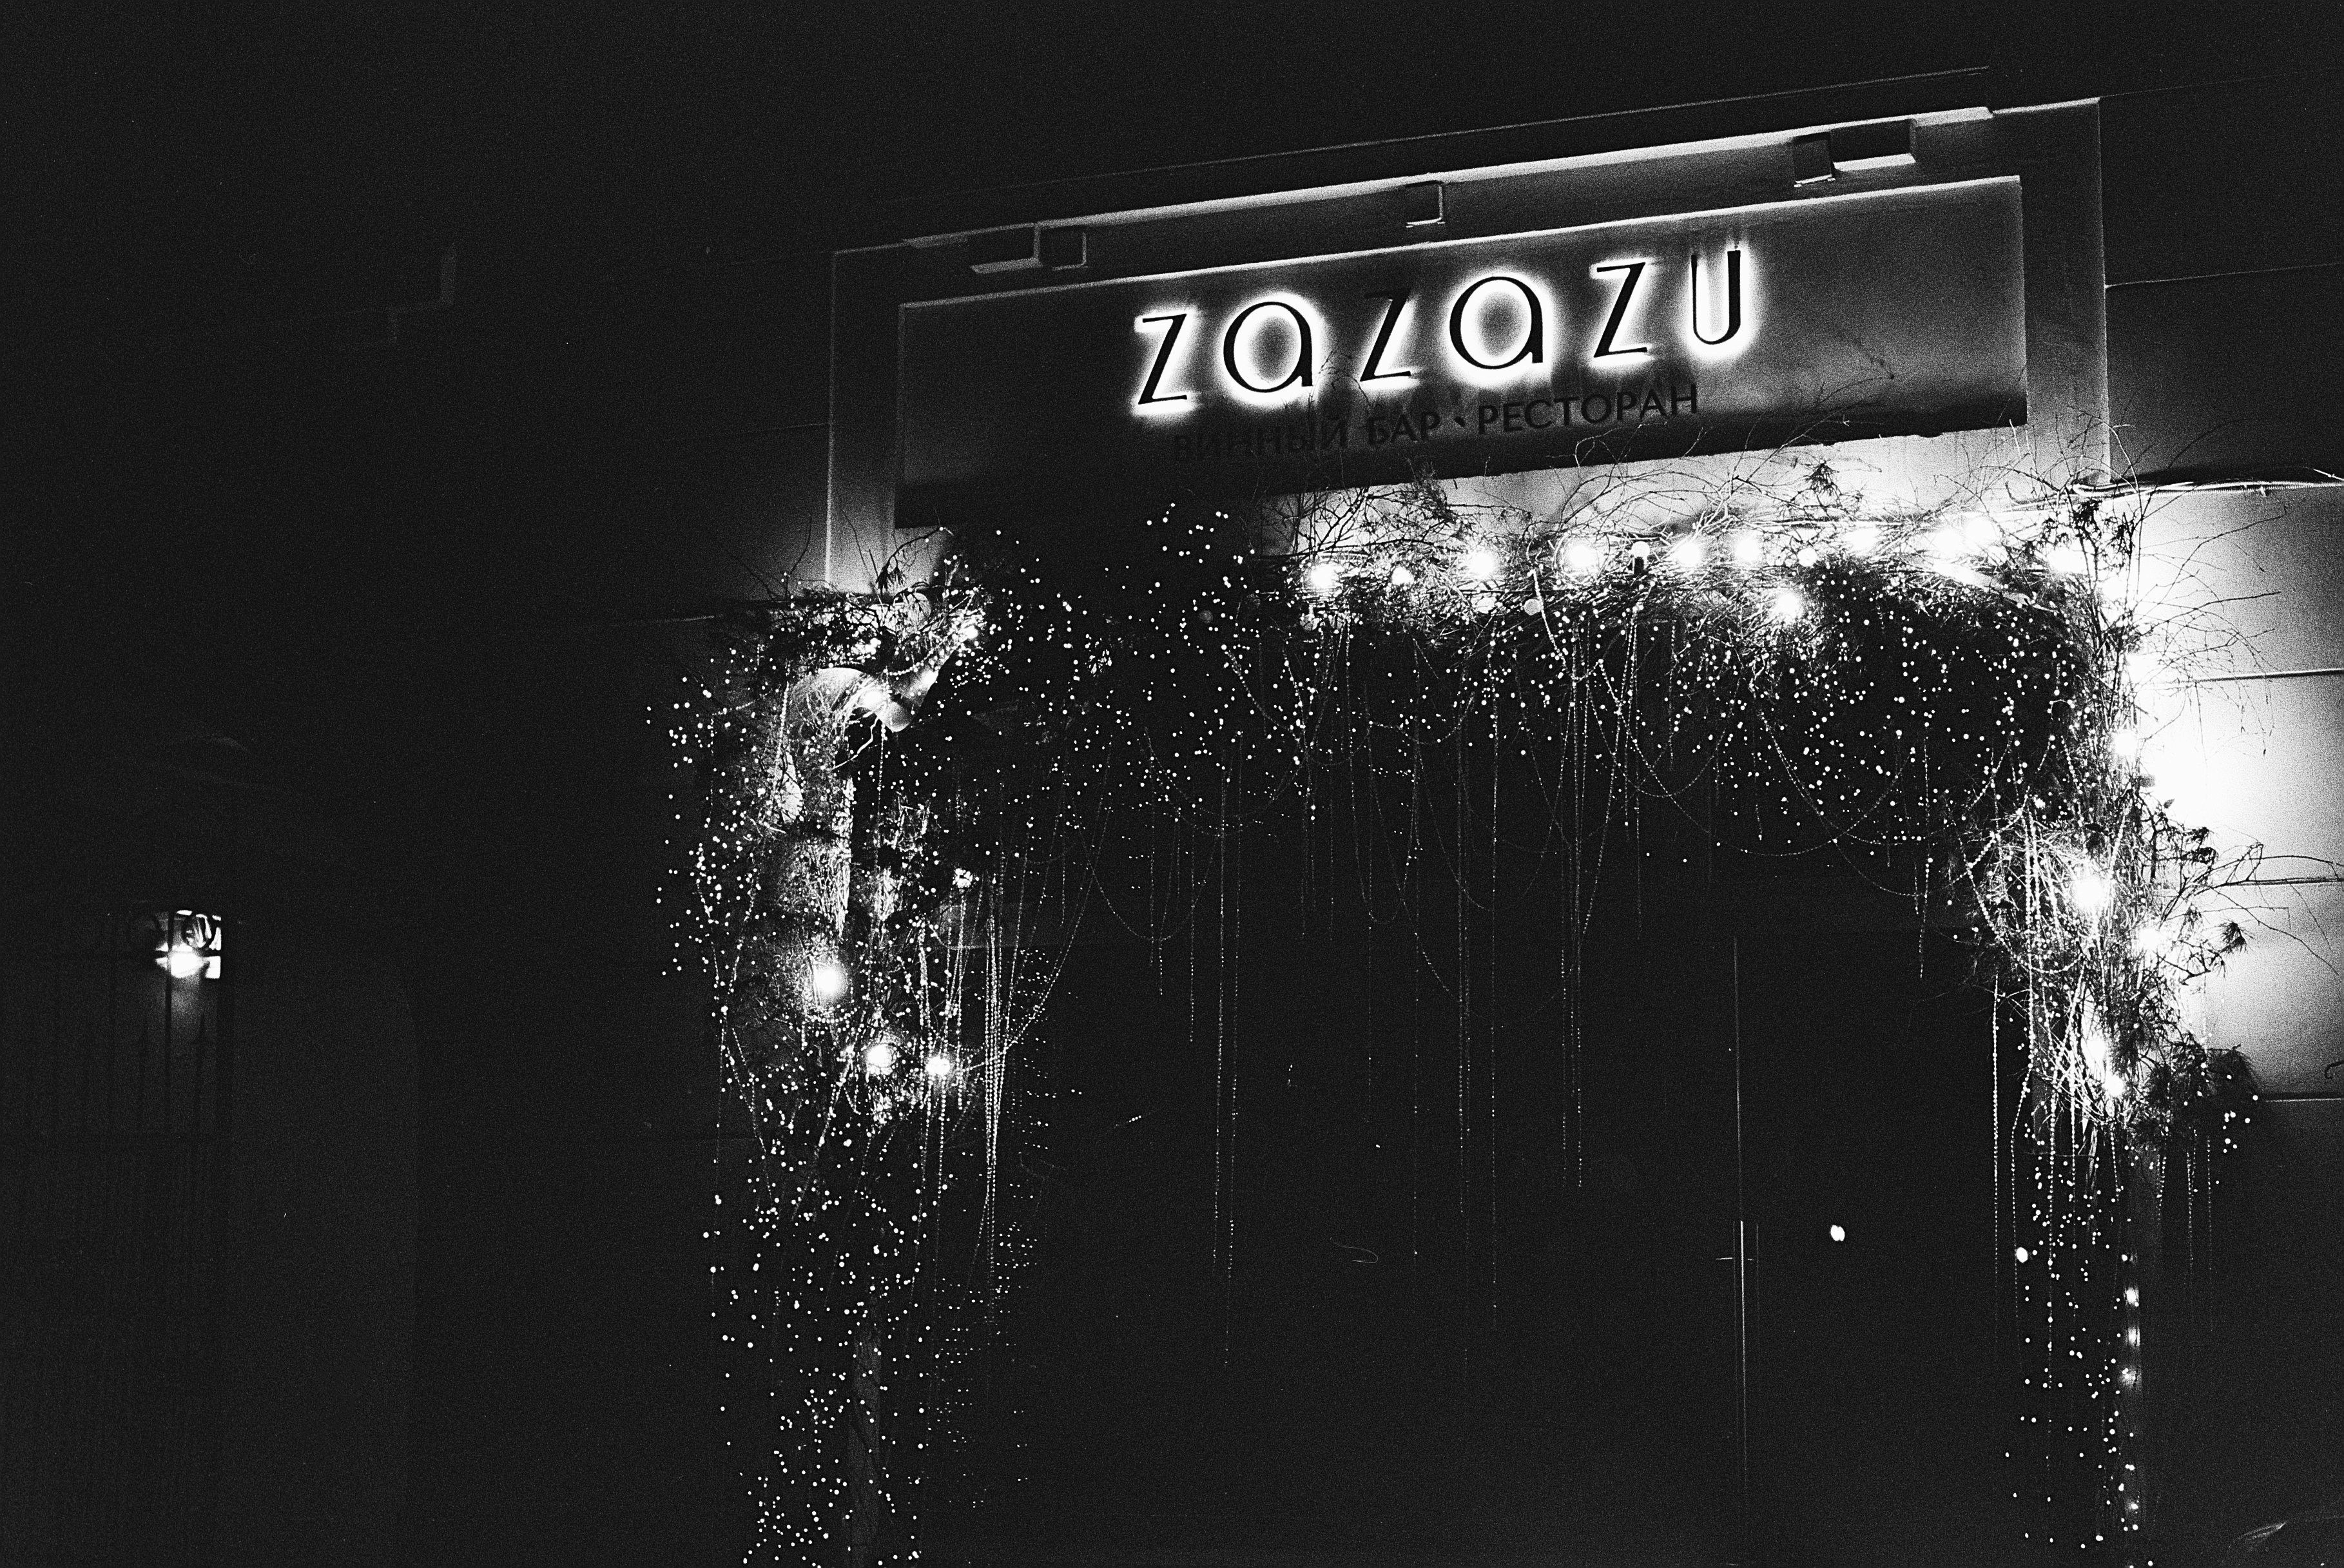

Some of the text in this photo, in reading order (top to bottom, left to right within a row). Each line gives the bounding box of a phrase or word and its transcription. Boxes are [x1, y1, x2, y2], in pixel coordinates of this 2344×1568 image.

[1174, 383, 1698, 462] ВИННЫЙ БАР РЕСТОРАН
